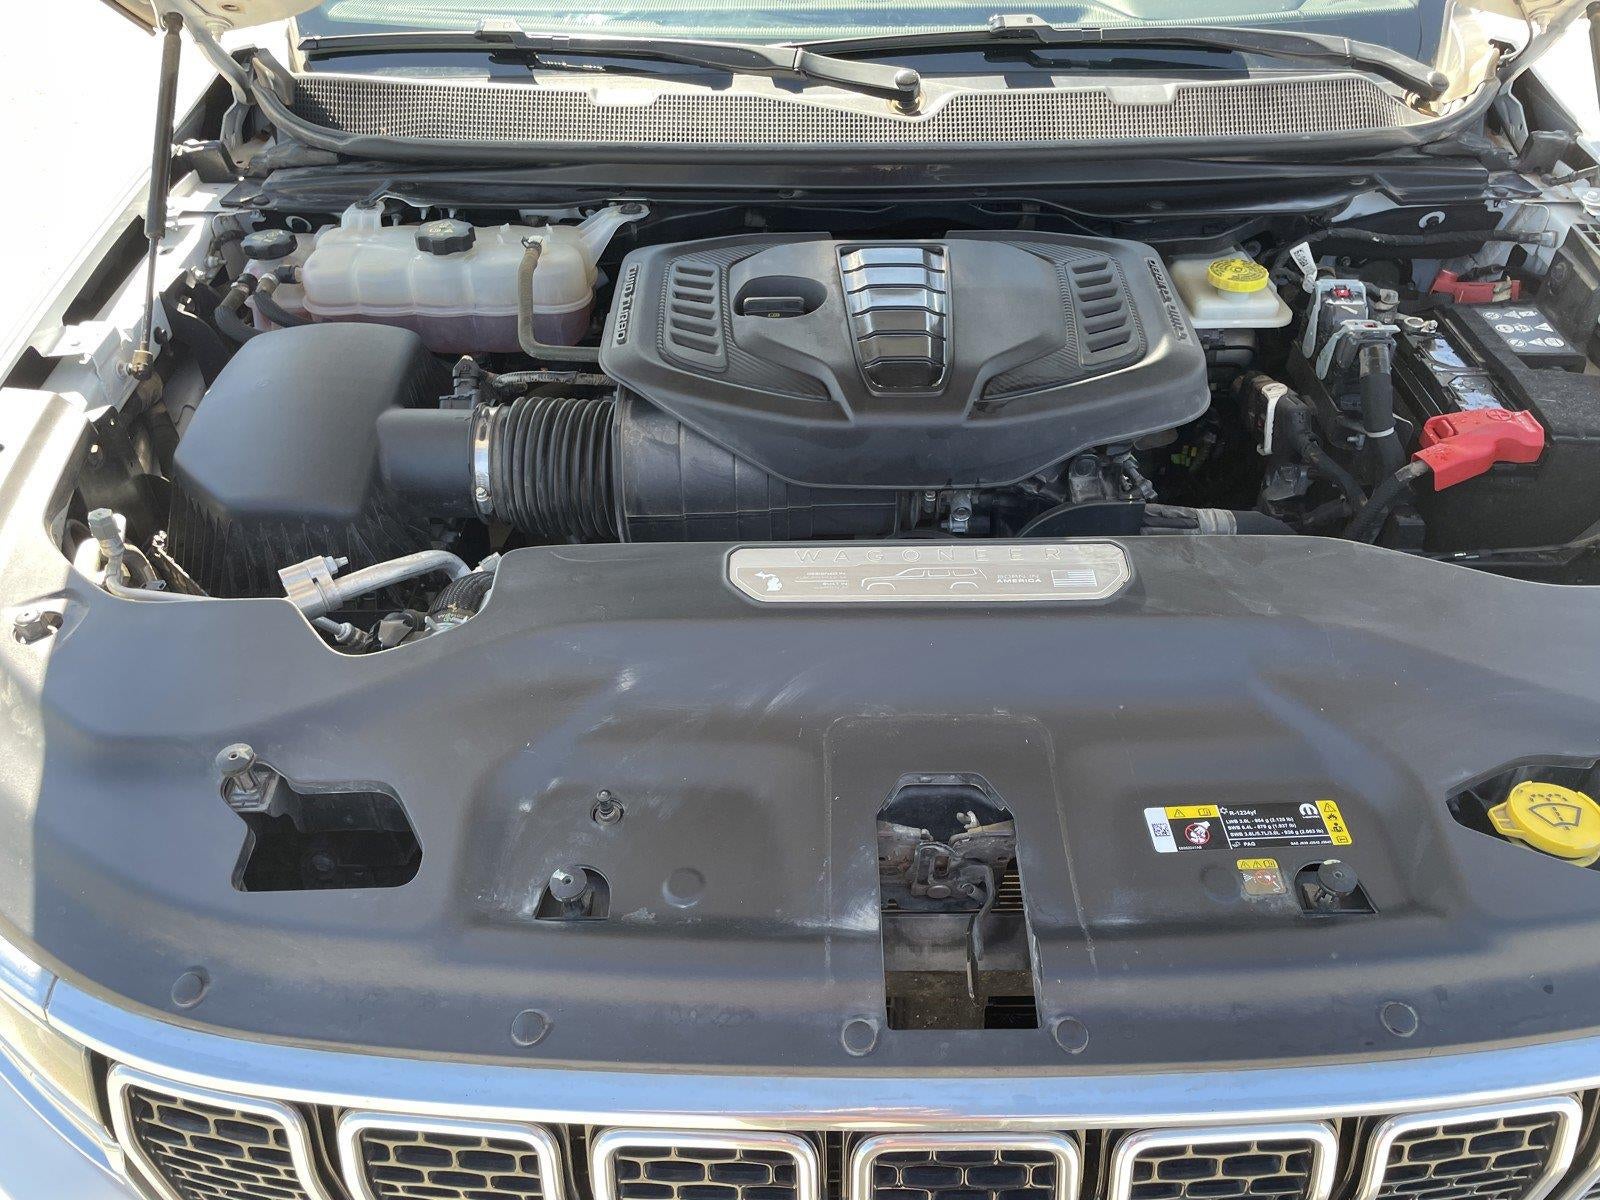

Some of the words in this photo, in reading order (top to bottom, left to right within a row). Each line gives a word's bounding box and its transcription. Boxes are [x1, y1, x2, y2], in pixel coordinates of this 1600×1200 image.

[616, 297, 633, 345] TURBO
[794, 548, 1062, 563] WAGONEER
[1228, 809, 1257, 817] R-1234yf
